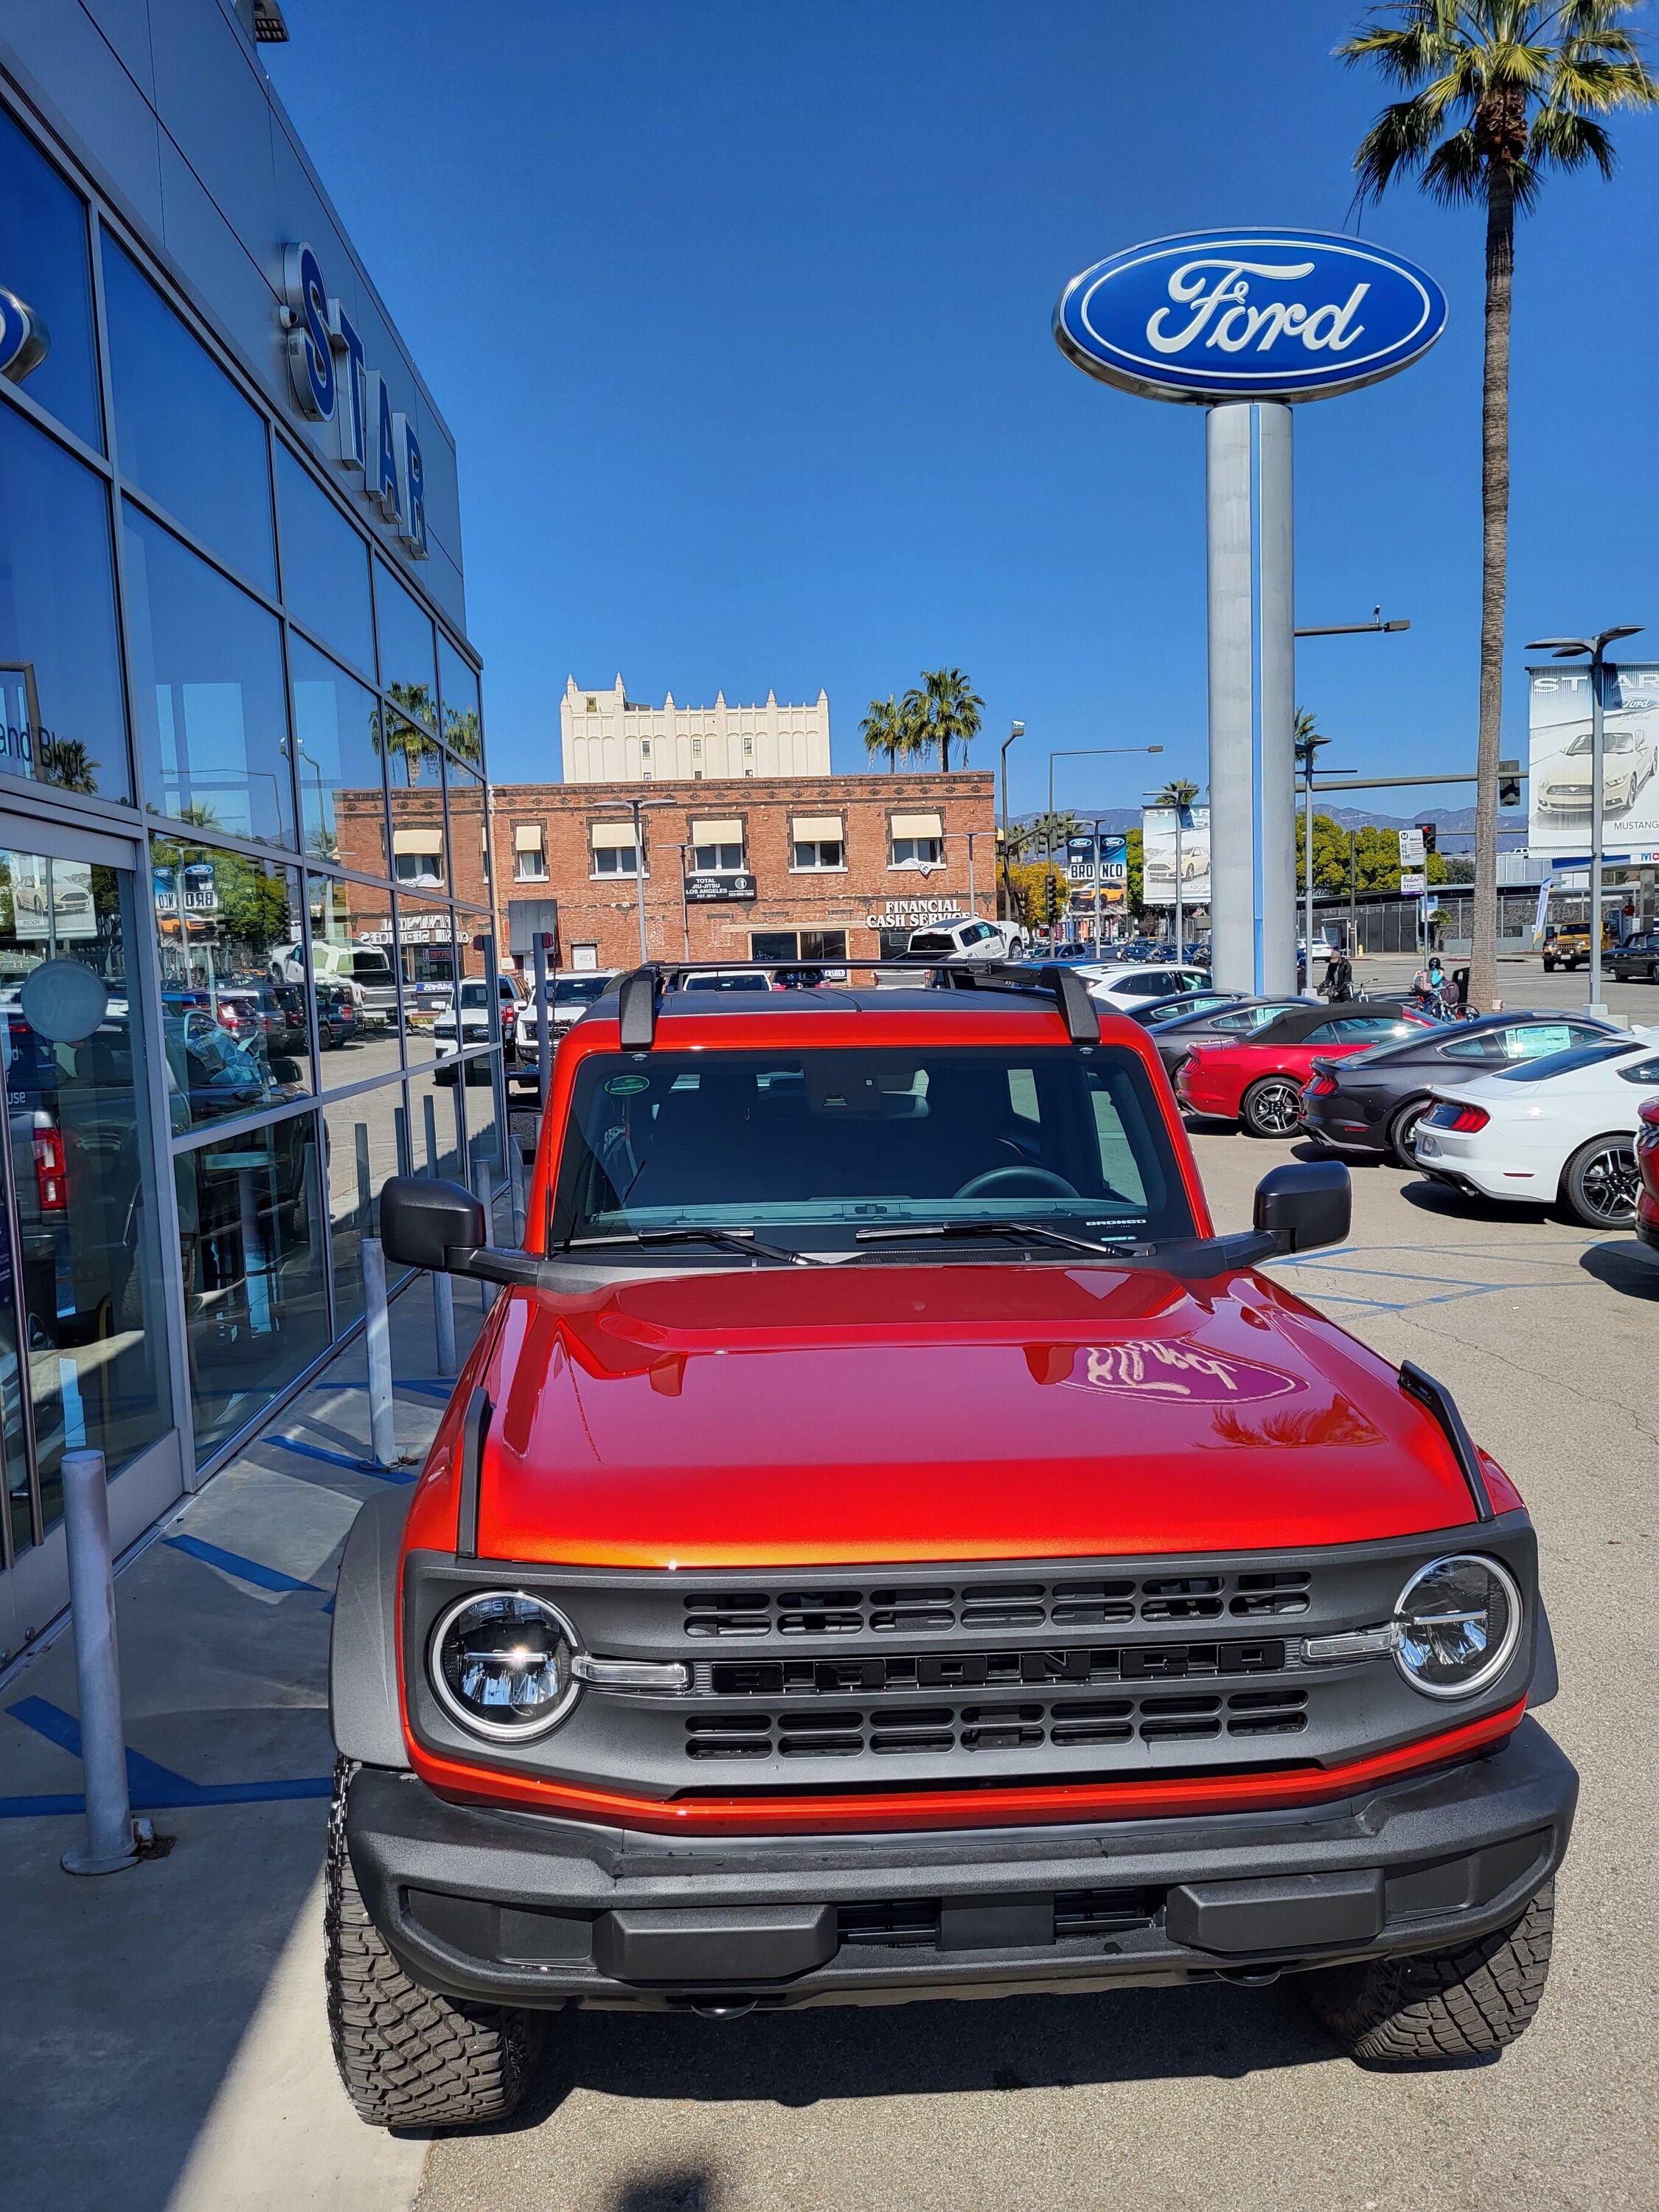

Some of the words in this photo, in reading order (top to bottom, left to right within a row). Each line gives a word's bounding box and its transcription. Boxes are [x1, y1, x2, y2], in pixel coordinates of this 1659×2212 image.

[1146, 259, 1371, 354] Ford
[286, 242, 429, 560] STAR
[1534, 673, 1659, 693] STAR
[1614, 820, 1659, 830] MUSTANG
[885, 900, 961, 914] FINANCIAL
[866, 914, 905, 928] CASH
[712, 1638, 1285, 1694] BRONCO
